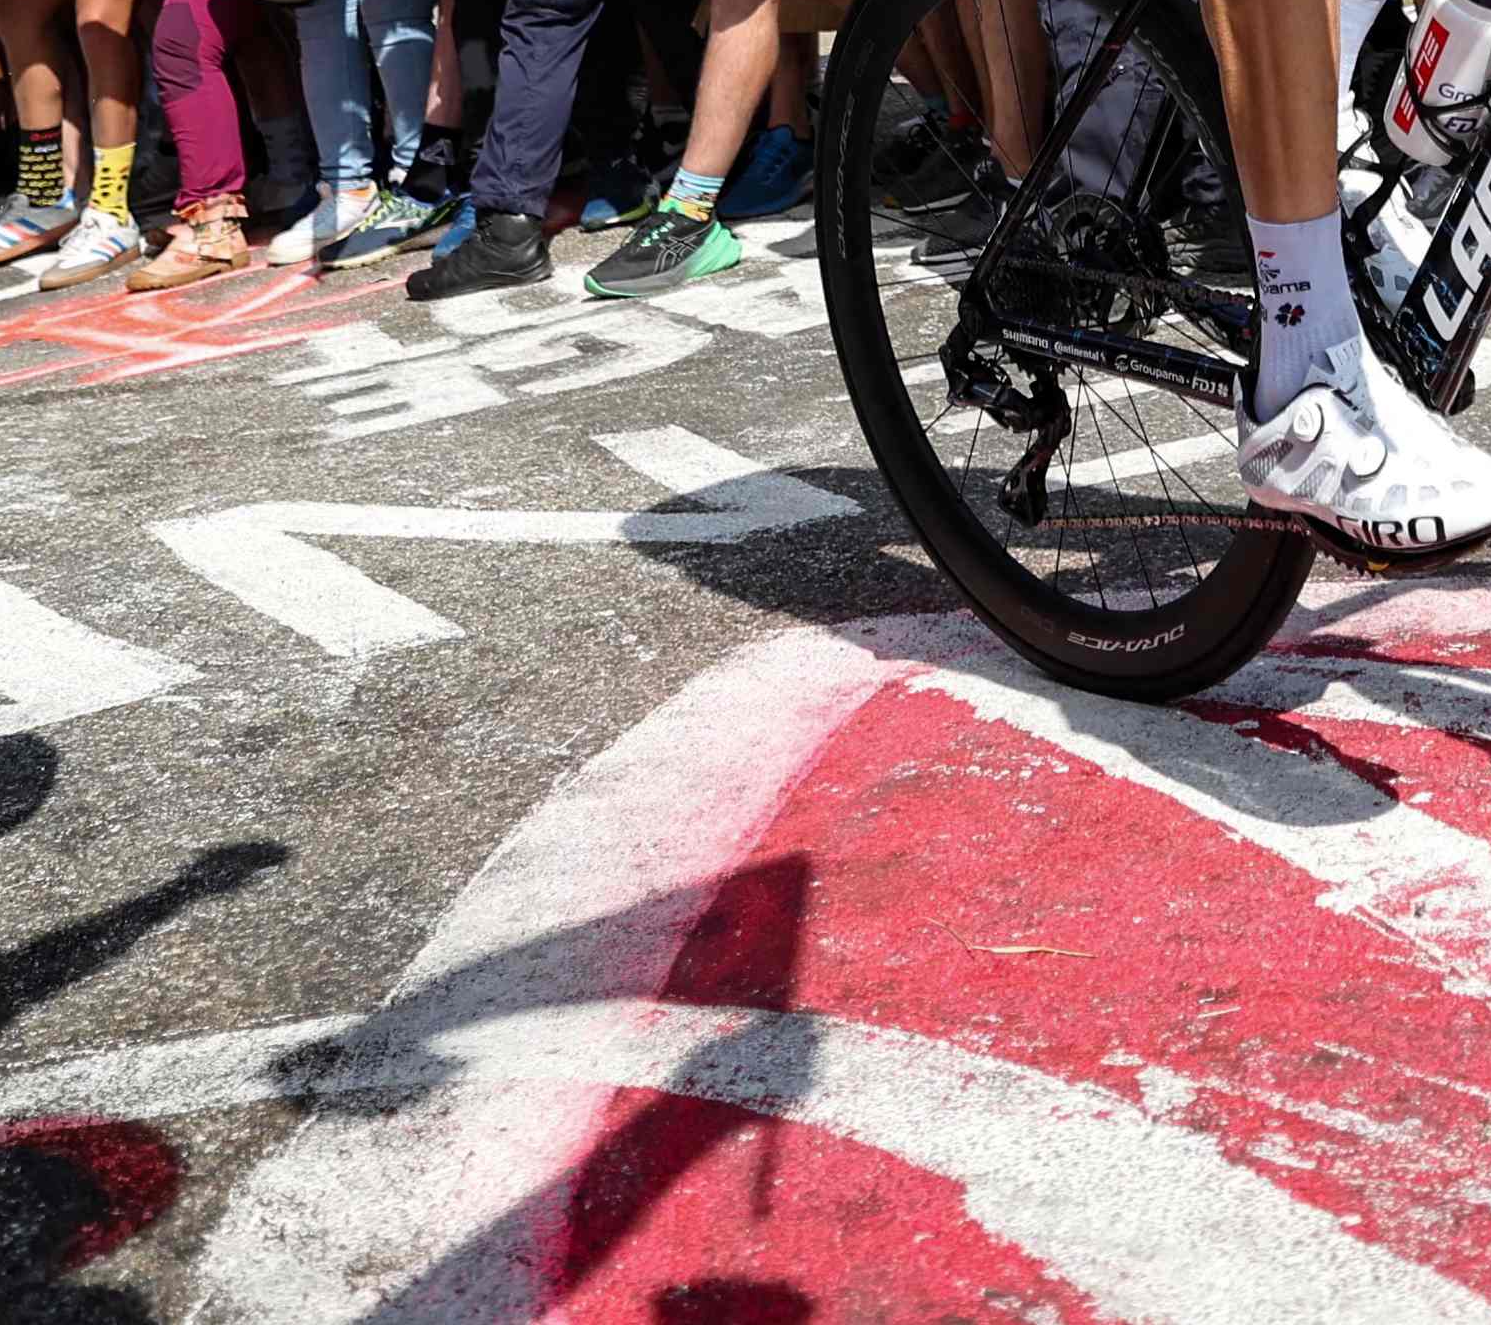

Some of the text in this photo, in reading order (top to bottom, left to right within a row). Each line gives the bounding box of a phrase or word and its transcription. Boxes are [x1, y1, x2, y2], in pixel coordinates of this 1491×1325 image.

[1001, 327, 1100, 361] SHIMANO Continental
[1129, 359, 1217, 395] Groupama FDJ
[1066, 622, 1187, 653] DURA-ACE
